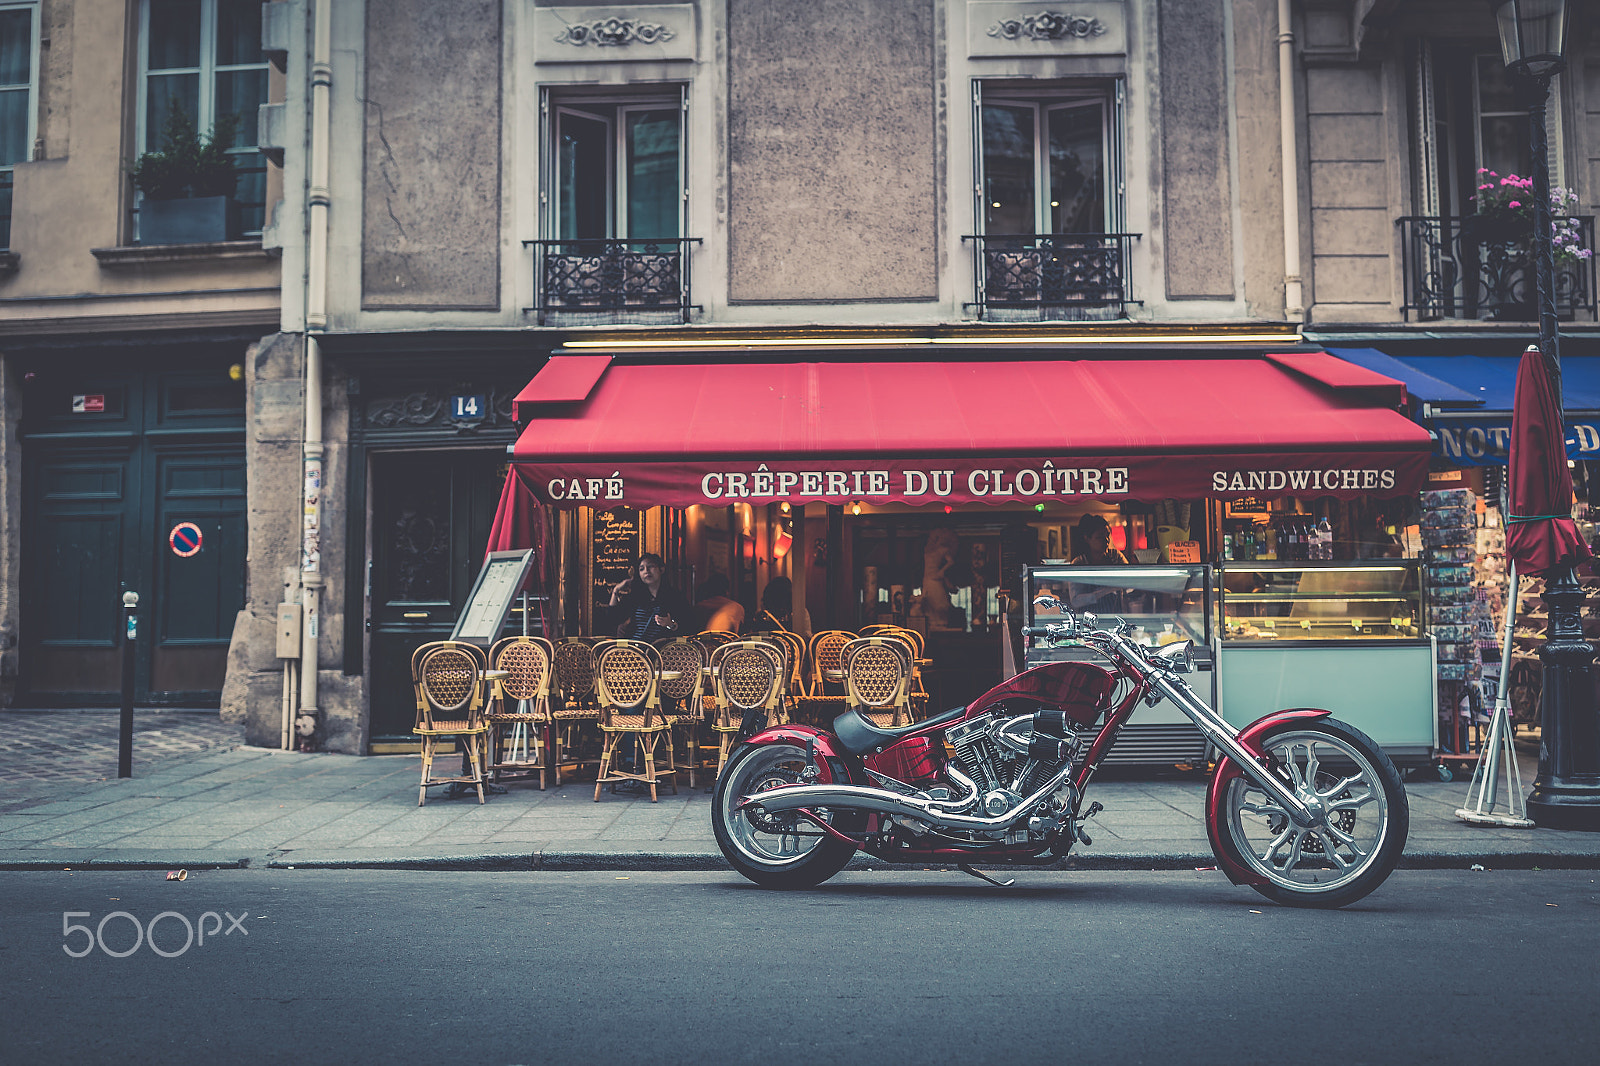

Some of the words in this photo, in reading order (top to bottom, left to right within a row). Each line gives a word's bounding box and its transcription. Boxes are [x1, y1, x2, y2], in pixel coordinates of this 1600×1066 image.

[457, 396, 478, 416] 14
[547, 470, 625, 500] CAFÉ
[701, 463, 890, 499] CRÊPERIE
[903, 470, 955, 496] DU
[968, 460, 1129, 496] CLOÎTRE
[1212, 469, 1396, 492] SANDWICHES
